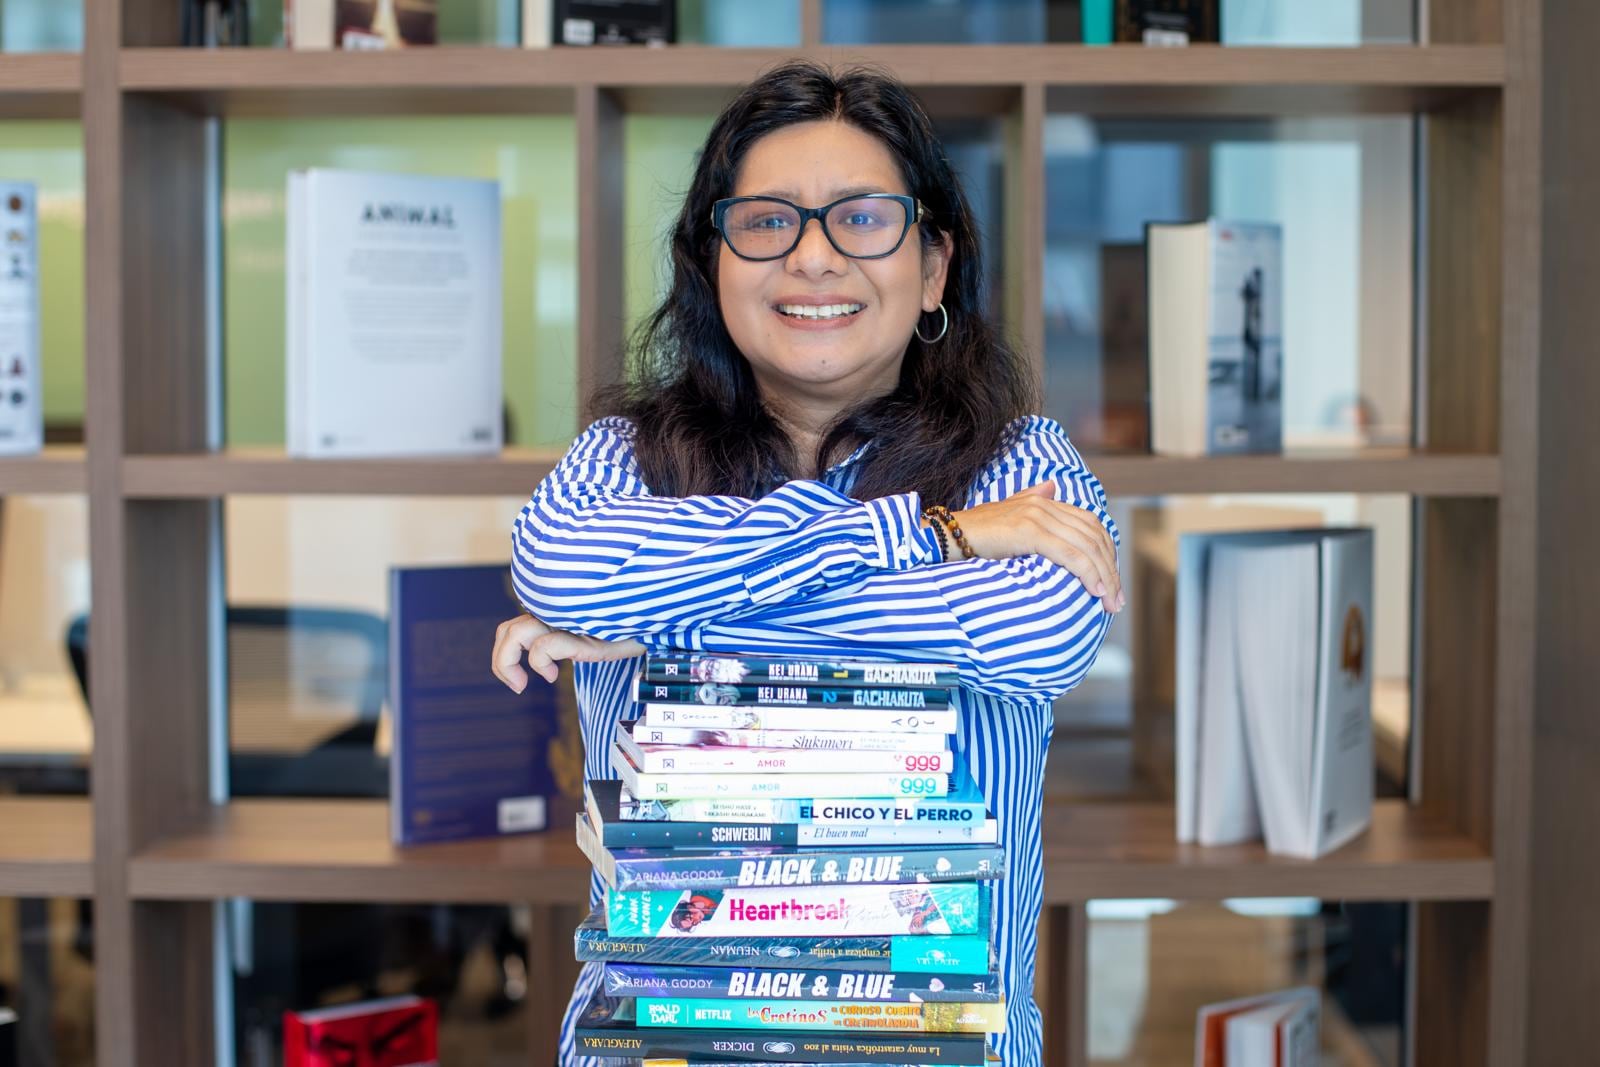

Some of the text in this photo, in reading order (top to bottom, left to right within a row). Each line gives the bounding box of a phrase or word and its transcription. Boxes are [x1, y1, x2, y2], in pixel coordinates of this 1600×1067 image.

[768, 664, 818, 677] KEI URANA
[864, 666, 936, 684] GACHIAKUTA
[758, 687, 808, 700] KEI URANA
[823, 691, 837, 703] 2
[853, 690, 926, 708] GACHIAKUTA
[757, 760, 786, 768] AMOR
[905, 755, 940, 771] 999
[901, 778, 936, 794] 999
[800, 806, 973, 821] EL CHICO Y EL PERRO
[712, 827, 772, 842] SCHWEBLIN
[813, 827, 868, 838] El buen mal
[634, 870, 723, 882] ARIANA GODOY
[738, 856, 904, 886] BLACK & BLUE
[588, 942, 647, 953] ALFAGUARA
[711, 946, 760, 956] NEUMAN
[626, 978, 713, 988] ARIANA GODOY
[728, 972, 896, 998] BLACK & BLUE
[648, 1004, 680, 1015] ROALD
[695, 1009, 732, 1020] NETFLIX
[840, 1006, 881, 1014] CURIOSO
[651, 1013, 677, 1024] DAHL
[584, 1038, 643, 1048] ALFAGUARA
[713, 1042, 754, 1051] DICKER
[832, 1044, 854, 1053] visita
[907, 1044, 926, 1053] muy
[822, 1044, 830, 1054] al
[857, 1044, 904, 1054] catastrófica
[930, 1047, 940, 1056] La
